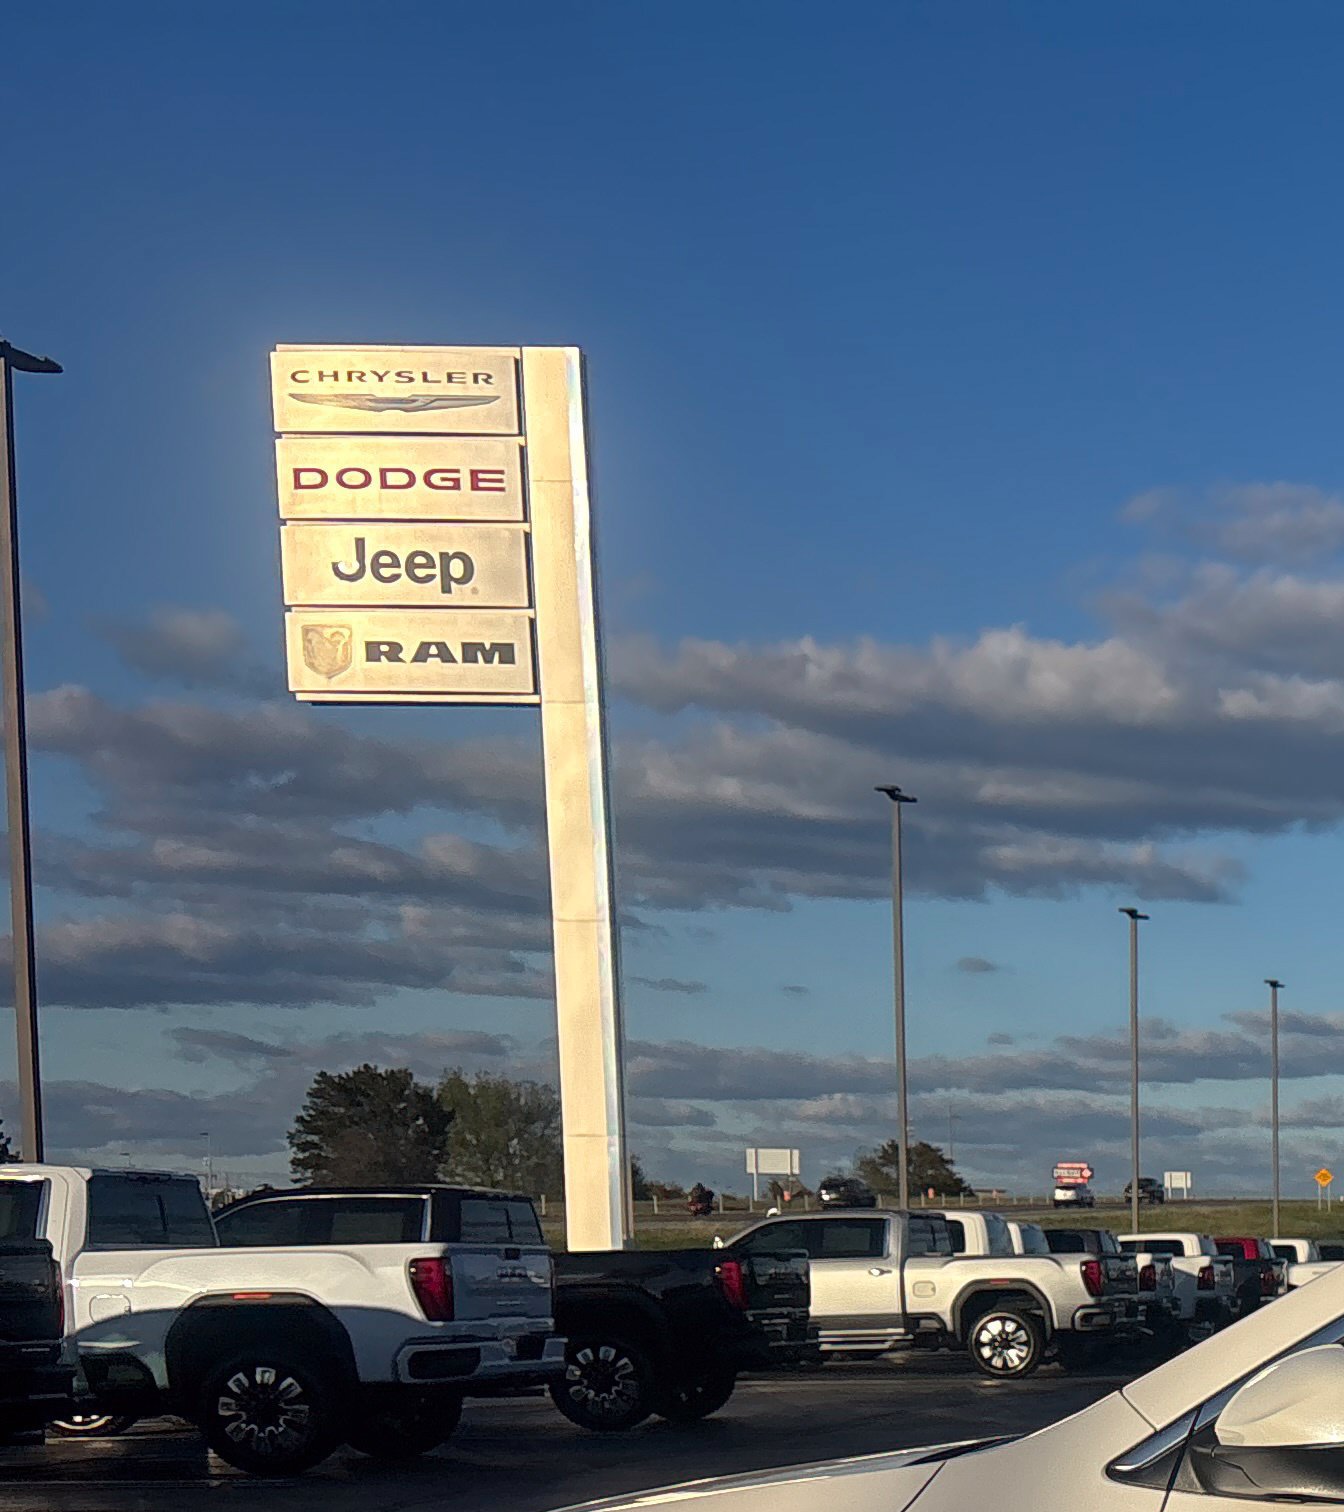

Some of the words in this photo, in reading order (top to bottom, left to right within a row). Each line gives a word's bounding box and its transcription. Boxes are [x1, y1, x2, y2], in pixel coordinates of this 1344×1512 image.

[290, 370, 495, 386] CHRYSLER
[292, 467, 506, 492] DODGE
[331, 537, 475, 594] Jeep
[364, 640, 516, 665] RAM
